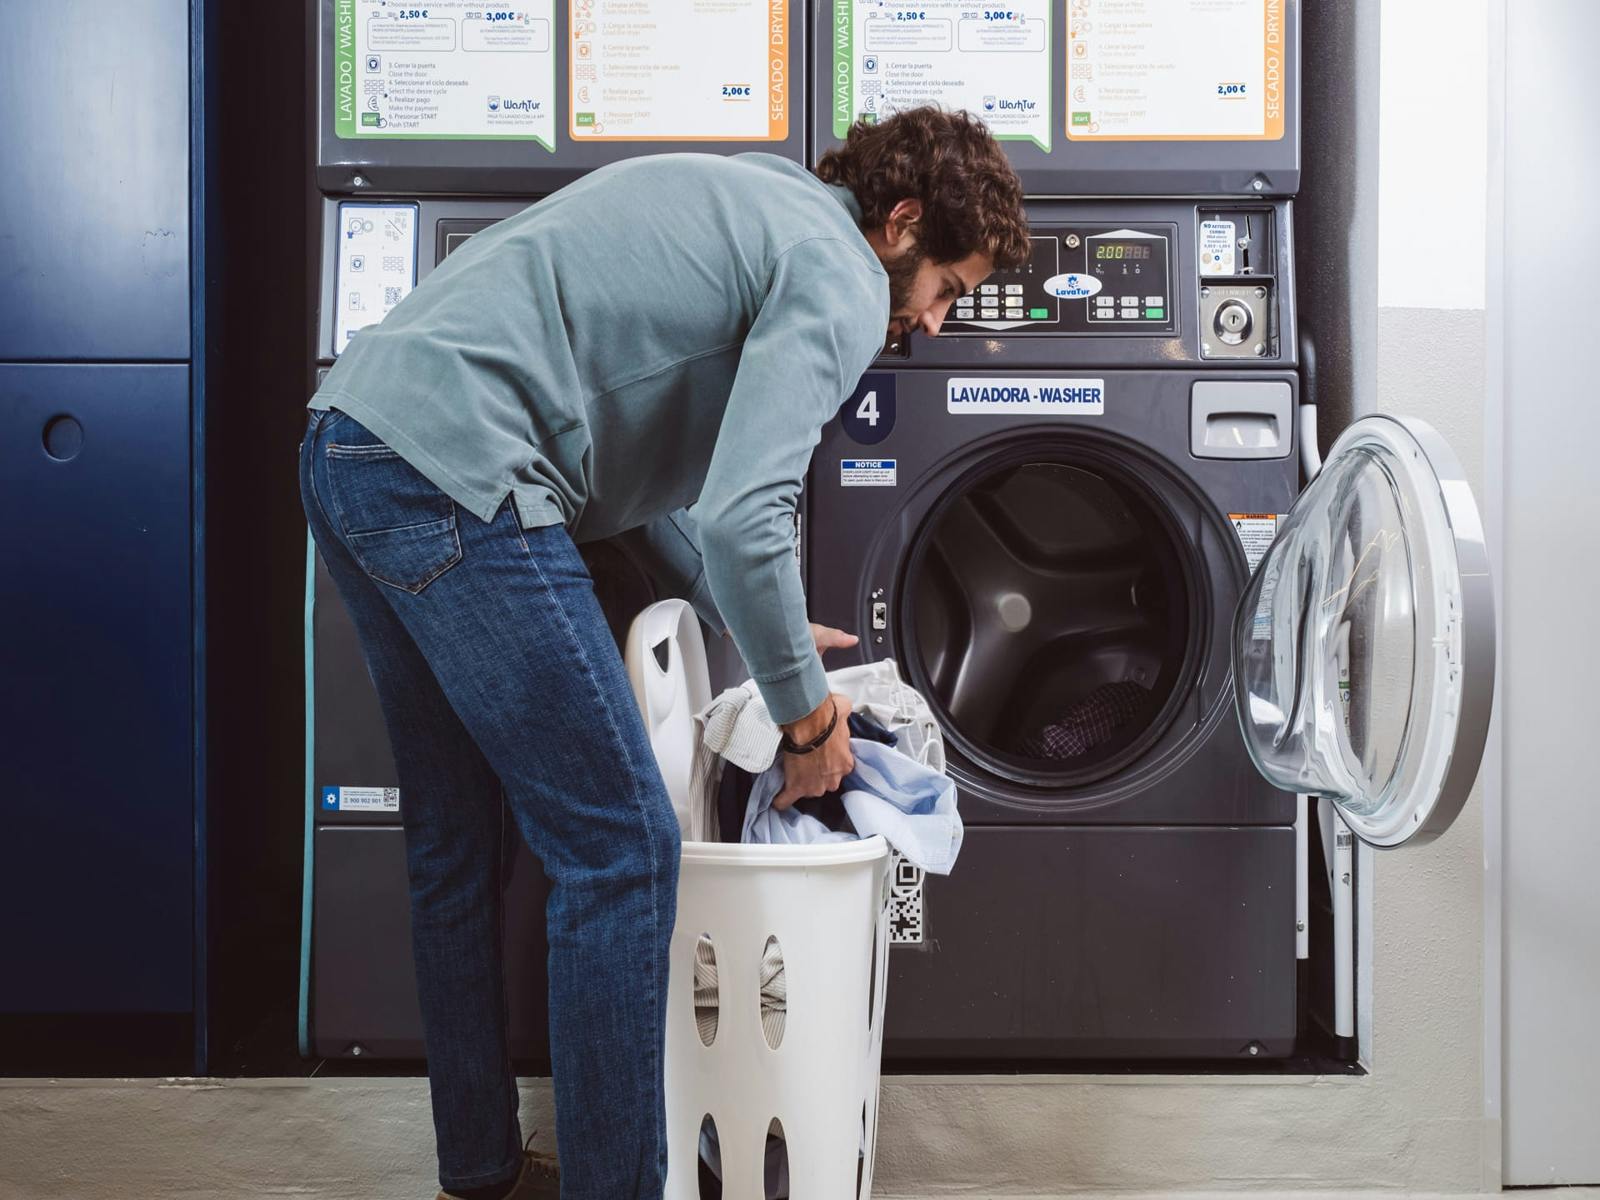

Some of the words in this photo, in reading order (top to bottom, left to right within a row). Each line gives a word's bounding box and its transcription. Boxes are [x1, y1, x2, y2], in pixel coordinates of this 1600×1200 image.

[400, 10, 420, 20] 2,50
[422, 10, 428, 18] €
[486, 12, 507, 22] 3,00
[508, 12, 514, 20] €
[897, 12, 918, 21] 2,50
[920, 12, 926, 20] €
[984, 12, 1005, 21] 3,00
[1006, 12, 1012, 20] €
[838, 1, 850, 49] WASHI
[340, 61, 352, 121] LAVADO
[722, 87, 743, 96] 2,00
[744, 88, 750, 96] €
[772, 59, 784, 121] SECADO
[838, 62, 850, 122] LAVADO
[1218, 85, 1238, 96] 2,00
[1240, 84, 1246, 93] €
[1267, 57, 1280, 119] SECADO
[504, 100, 540, 112] WashTur
[1000, 100, 1036, 112] WashTur
[1056, 288, 1090, 296] LavaTur
[951, 387, 1030, 403] LAVADORA
[856, 390, 880, 426] 4
